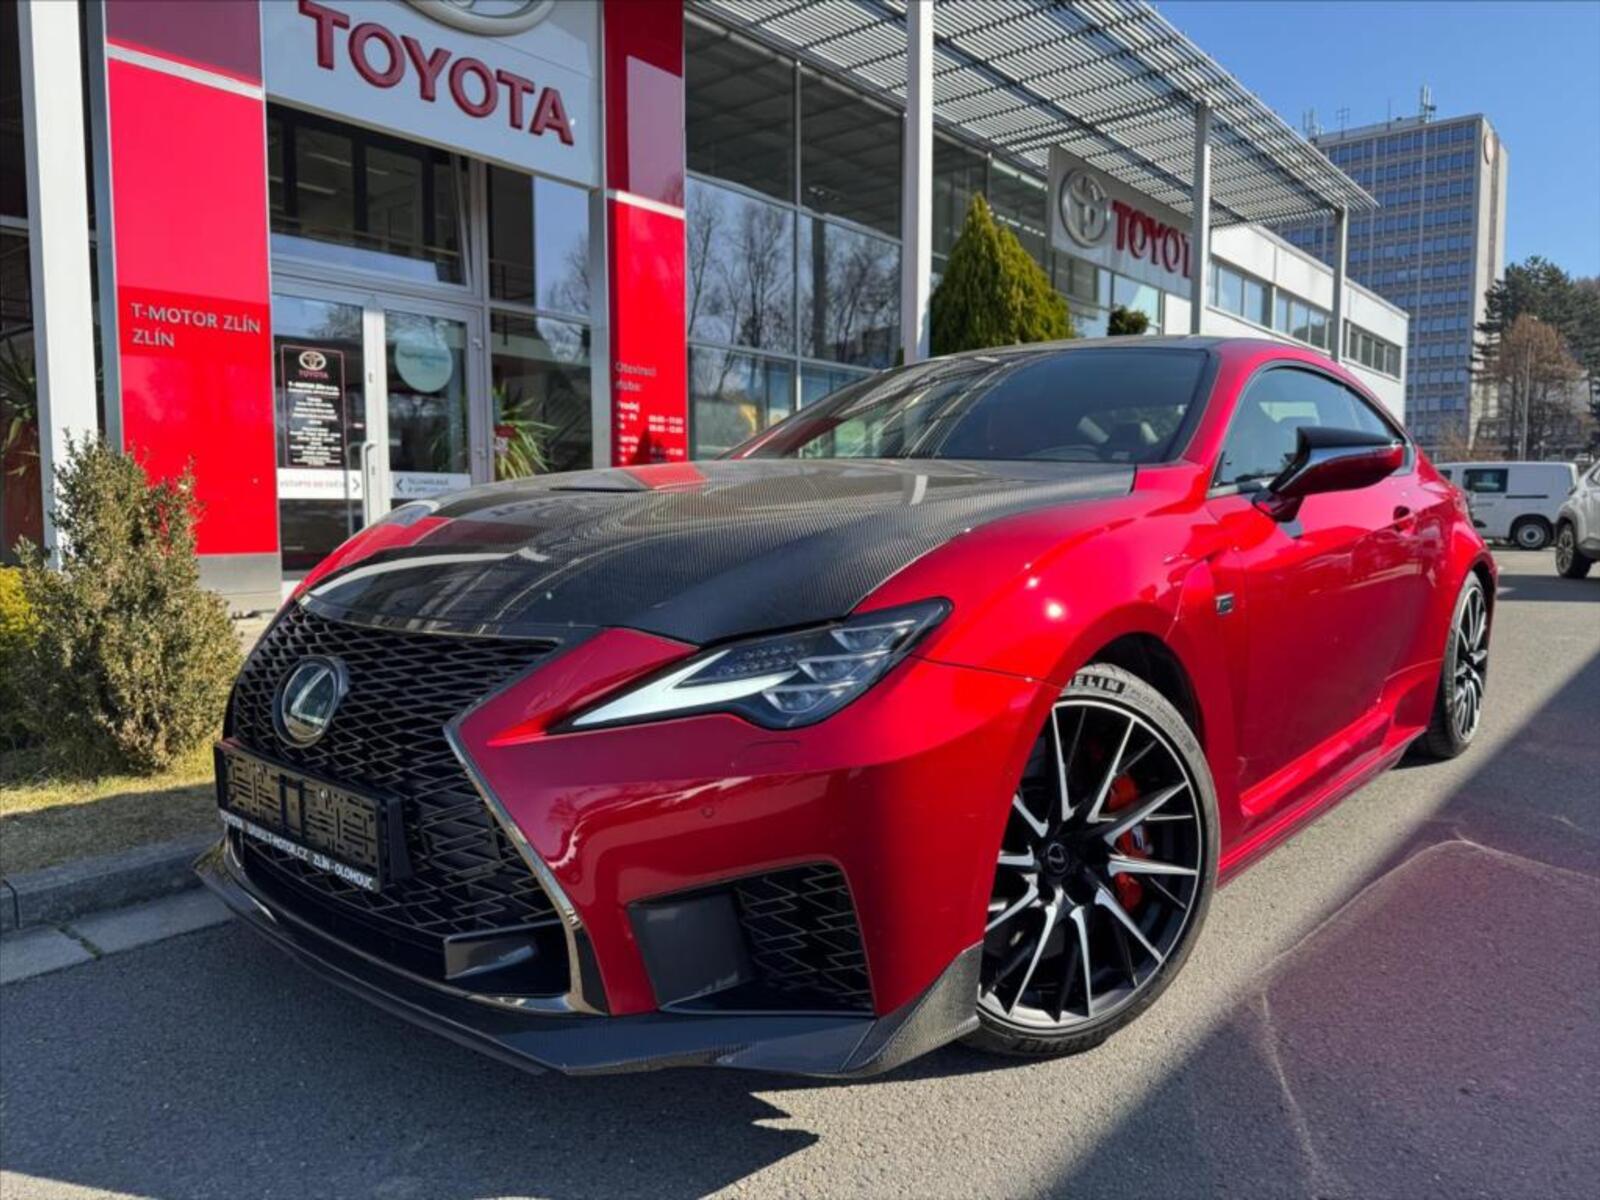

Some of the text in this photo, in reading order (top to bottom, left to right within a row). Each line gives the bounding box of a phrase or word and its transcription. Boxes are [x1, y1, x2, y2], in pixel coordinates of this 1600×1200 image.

[298, 0, 574, 146] TOYOTA
[130, 302, 261, 335] T-MOTOR ZLÍN
[132, 327, 176, 349] ZLÍN
[335, 863, 374, 891] OLOMOUC
